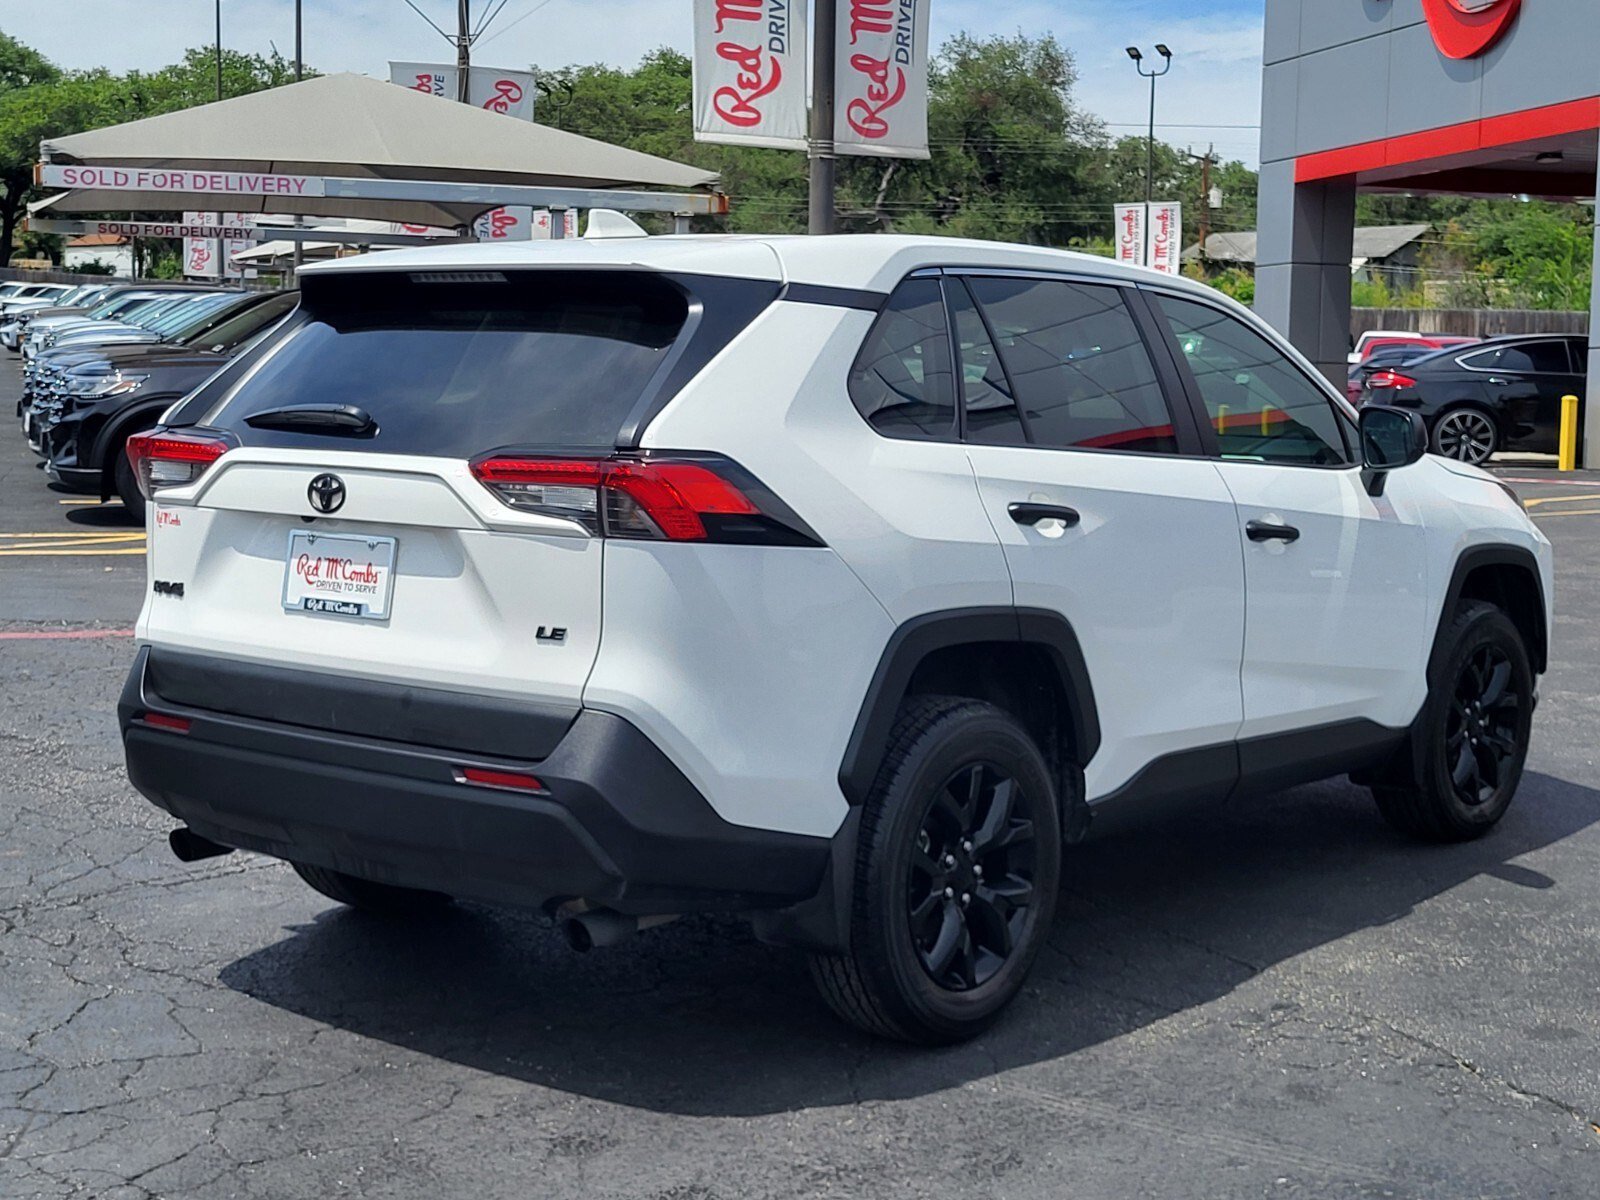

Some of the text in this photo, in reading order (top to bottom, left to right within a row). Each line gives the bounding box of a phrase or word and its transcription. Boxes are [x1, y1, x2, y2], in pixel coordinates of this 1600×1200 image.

[768, 0, 785, 54] DRIV
[895, 0, 912, 65] DRIVE
[483, 80, 523, 115] Re
[713, 42, 782, 127] Red
[847, 53, 906, 139] Red
[63, 169, 306, 194] SOLD FOR DELIVERY
[98, 222, 252, 239] SOLD FOR DELIVERY
[297, 553, 378, 585] Red McCombs
[316, 580, 377, 594] DRIVEN TO SERVE
[535, 625, 568, 641] LE
